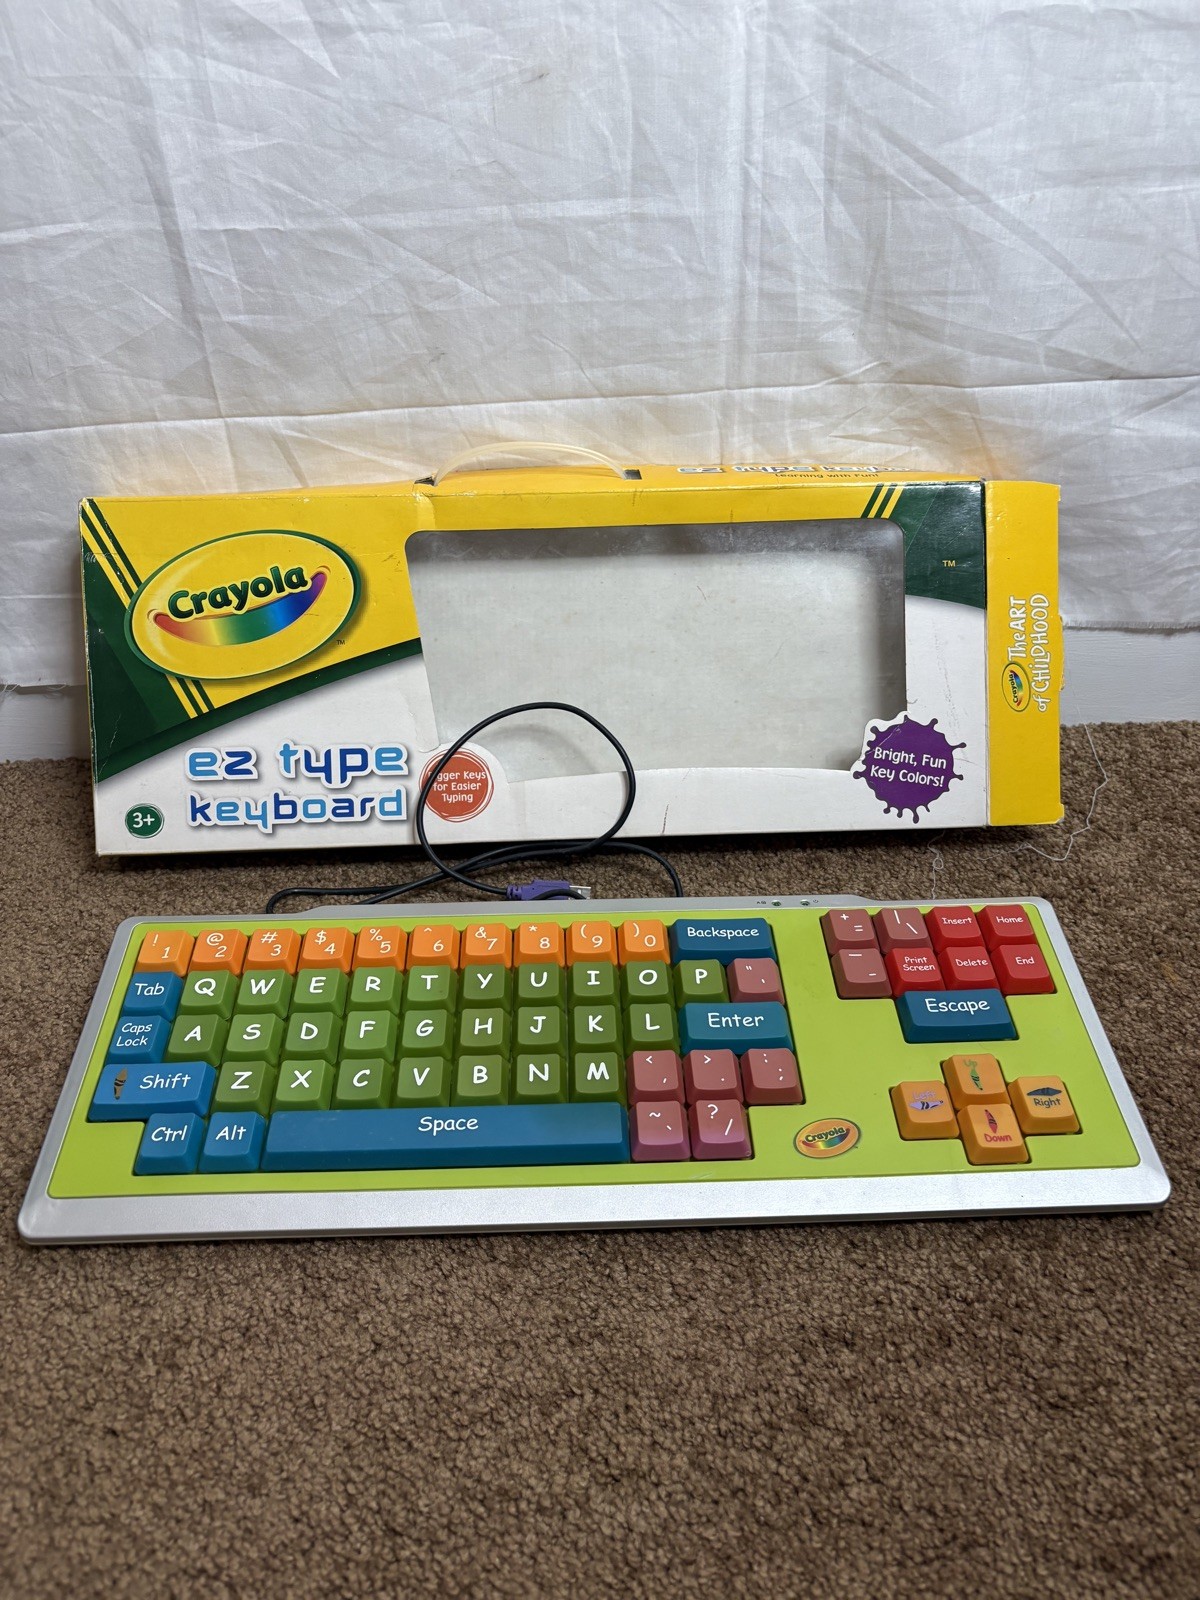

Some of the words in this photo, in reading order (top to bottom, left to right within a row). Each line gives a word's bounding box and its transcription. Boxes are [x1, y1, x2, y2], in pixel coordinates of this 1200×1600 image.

[168, 565, 308, 620] Crayola
[1009, 674, 1018, 703] Crayola
[1033, 694, 1050, 712] of
[187, 749, 256, 777] ez
[279, 743, 406, 785] type
[874, 747, 917, 766] Bright,
[922, 754, 946, 769] Fun
[463, 771, 486, 780] Keys
[870, 765, 895, 782] Key
[899, 770, 944, 787] Colors!
[433, 783, 448, 791] for
[451, 782, 481, 791] Easier
[442, 793, 473, 803] Typing
[190, 789, 404, 830] keyboard
[132, 812, 155, 829] 3+
[942, 917, 972, 925] Insert
[996, 916, 1024, 924] Home
[206, 932, 224, 946] @
[260, 931, 278, 944] #
[314, 930, 327, 945] $
[369, 928, 383, 941] %
[475, 926, 487, 939] &
[688, 927, 759, 939] Backspace
[324, 943, 336, 955] 4
[379, 941, 392, 954] 5
[433, 939, 444, 952] 6
[486, 938, 498, 950] 7
[539, 936, 551, 949] 8
[591, 935, 603, 948] 9
[161, 946, 171, 959] 1
[215, 945, 227, 958] 2
[270, 945, 282, 957] 3
[902, 963, 936, 972] Screen
[904, 956, 928, 965] Print
[366, 976, 380, 991] R
[421, 975, 438, 989] T
[477, 973, 492, 988] Y
[531, 972, 547, 987] U
[639, 970, 657, 985] O
[696, 969, 707, 984] P
[135, 983, 164, 995] Tab
[195, 978, 216, 996] Q
[251, 979, 275, 994] W
[310, 977, 326, 993] E
[925, 999, 990, 1014] Escape
[474, 1018, 492, 1034] H
[530, 1016, 546, 1033] J
[589, 1015, 603, 1032] K
[646, 1014, 660, 1030] L
[707, 1012, 765, 1028] Enter
[121, 1022, 153, 1035] Caps
[184, 1026, 201, 1041] A
[243, 1024, 261, 1039] S
[301, 1022, 318, 1039] D
[360, 1021, 375, 1038] F
[416, 1020, 434, 1036] G
[116, 1035, 149, 1047] Lock
[587, 1062, 609, 1080] M
[963, 1059, 978, 1069] Up
[231, 1072, 252, 1089] Z
[291, 1070, 312, 1088] X
[353, 1070, 370, 1087] C
[414, 1068, 430, 1085] V
[473, 1066, 488, 1083] B
[529, 1064, 548, 1082] N
[140, 1073, 190, 1089] Shift
[912, 1091, 936, 1100] Left
[1033, 1097, 1061, 1108] Right
[707, 1103, 719, 1119] ?
[152, 1125, 187, 1141] Ctrl
[216, 1125, 246, 1140] Alt
[418, 1116, 478, 1136] Space
[805, 1126, 846, 1142] Crayola
[984, 1133, 1012, 1142] Down
